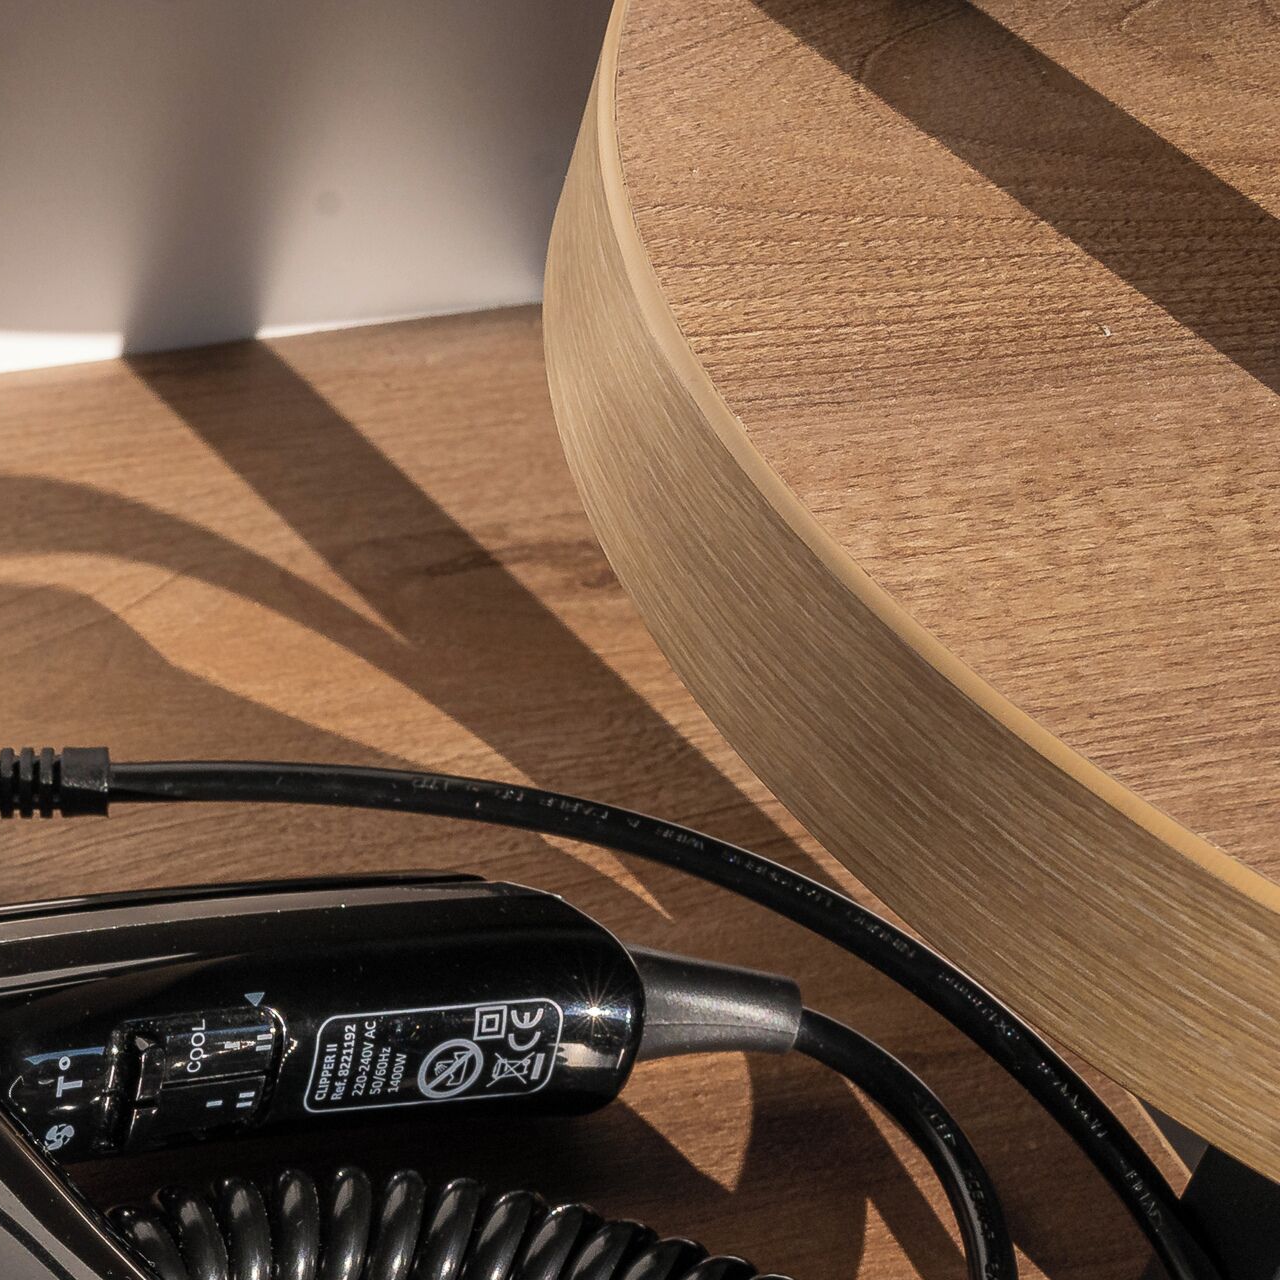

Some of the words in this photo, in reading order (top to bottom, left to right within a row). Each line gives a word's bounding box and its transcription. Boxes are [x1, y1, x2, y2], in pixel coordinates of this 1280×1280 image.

[187, 1019, 206, 1073] COOL
[338, 1024, 356, 1077] 8221192
[508, 1008, 544, 1051] CE
[315, 1054, 336, 1100] CLIPPER
[326, 1043, 338, 1052] II
[352, 1042, 374, 1096] 220-240V
[364, 1020, 376, 1039] AC
[369, 1046, 391, 1095] 50/60Hz
[387, 1053, 407, 1093] 1400W
[330, 1079, 347, 1100] Ref.
